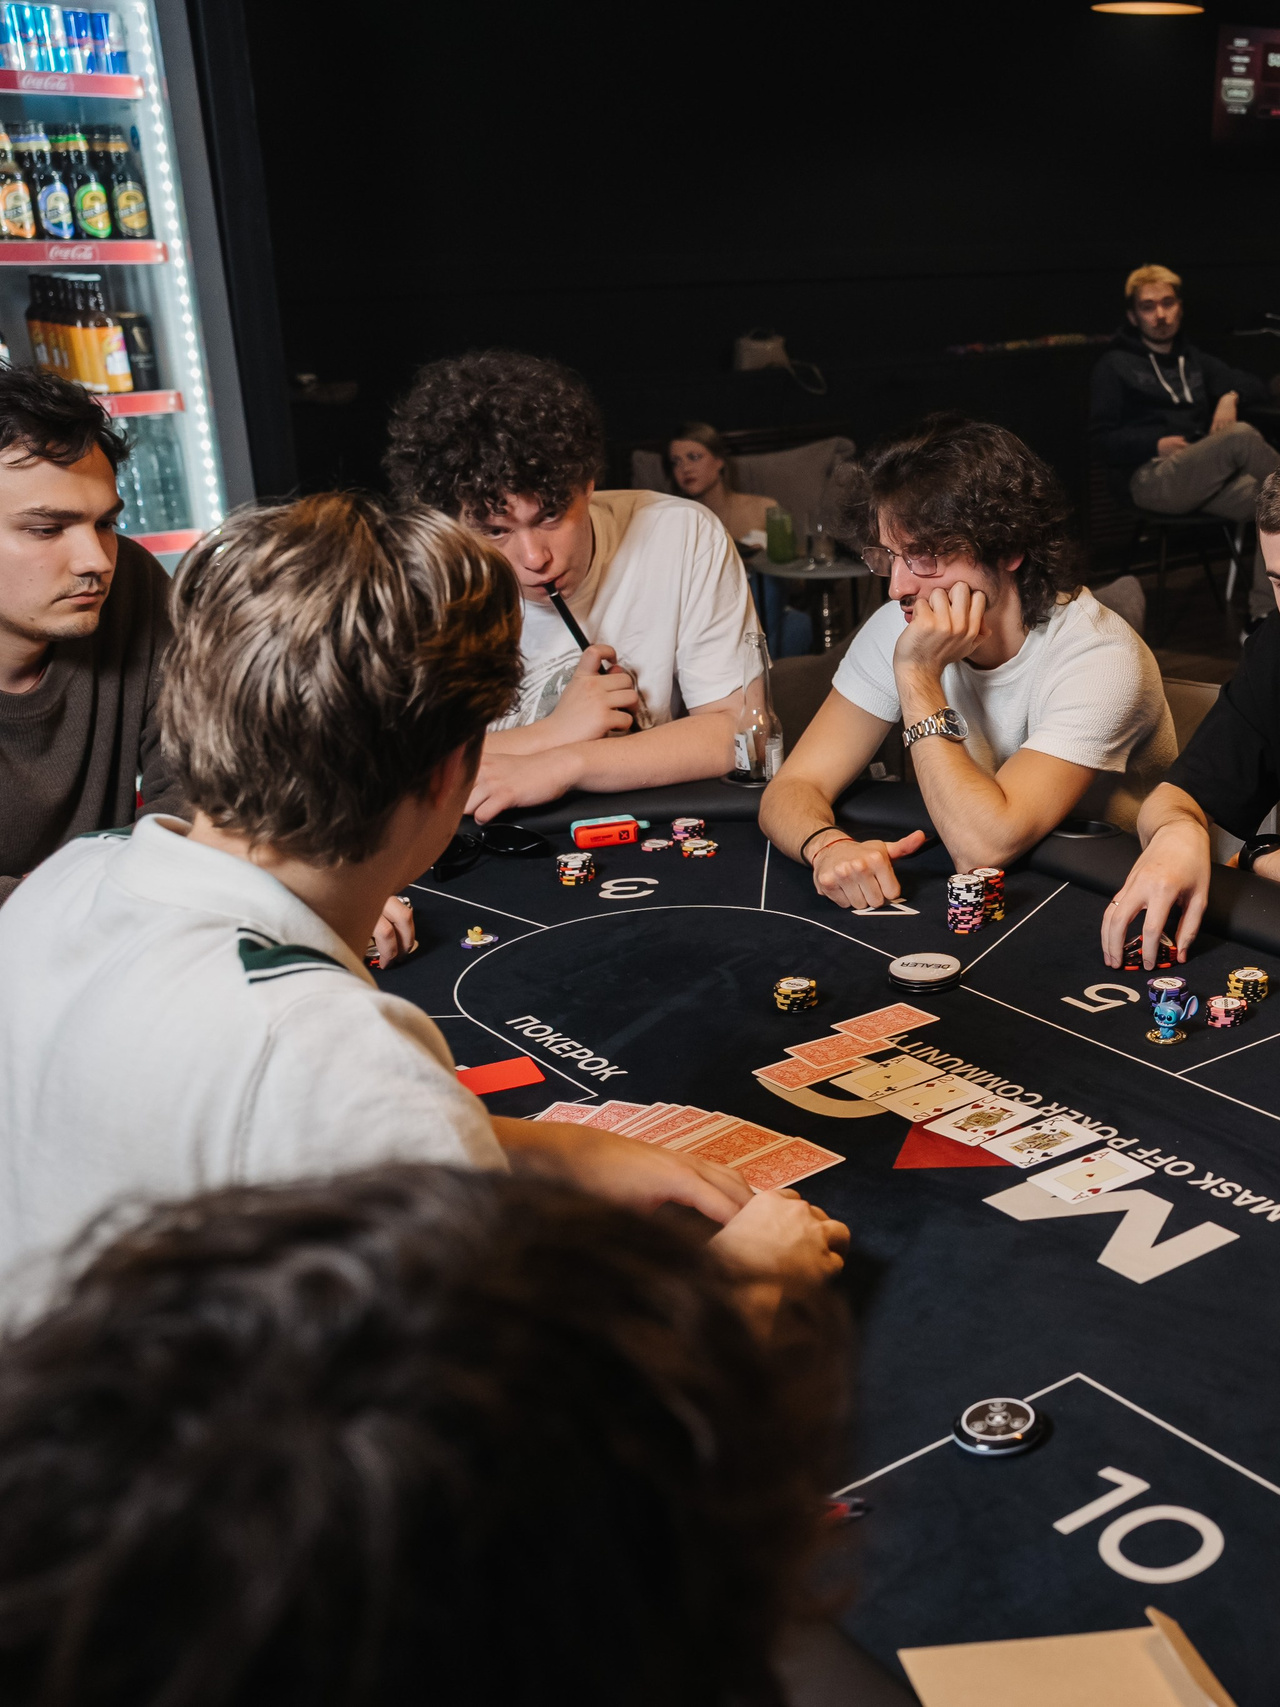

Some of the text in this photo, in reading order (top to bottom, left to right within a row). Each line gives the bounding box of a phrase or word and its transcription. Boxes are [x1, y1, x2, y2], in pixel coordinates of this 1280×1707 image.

[598, 877, 660, 899] 3
[900, 961, 952, 970] DEALER
[1060, 983, 1141, 1014] 5
[505, 1015, 628, 1082] ПОКЕРОК
[885, 1034, 1043, 1106] COMMUNITY
[1038, 1102, 1140, 1150] POKER
[1127, 1148, 1197, 1178] OFF
[1052, 1466, 1225, 1584] 10
